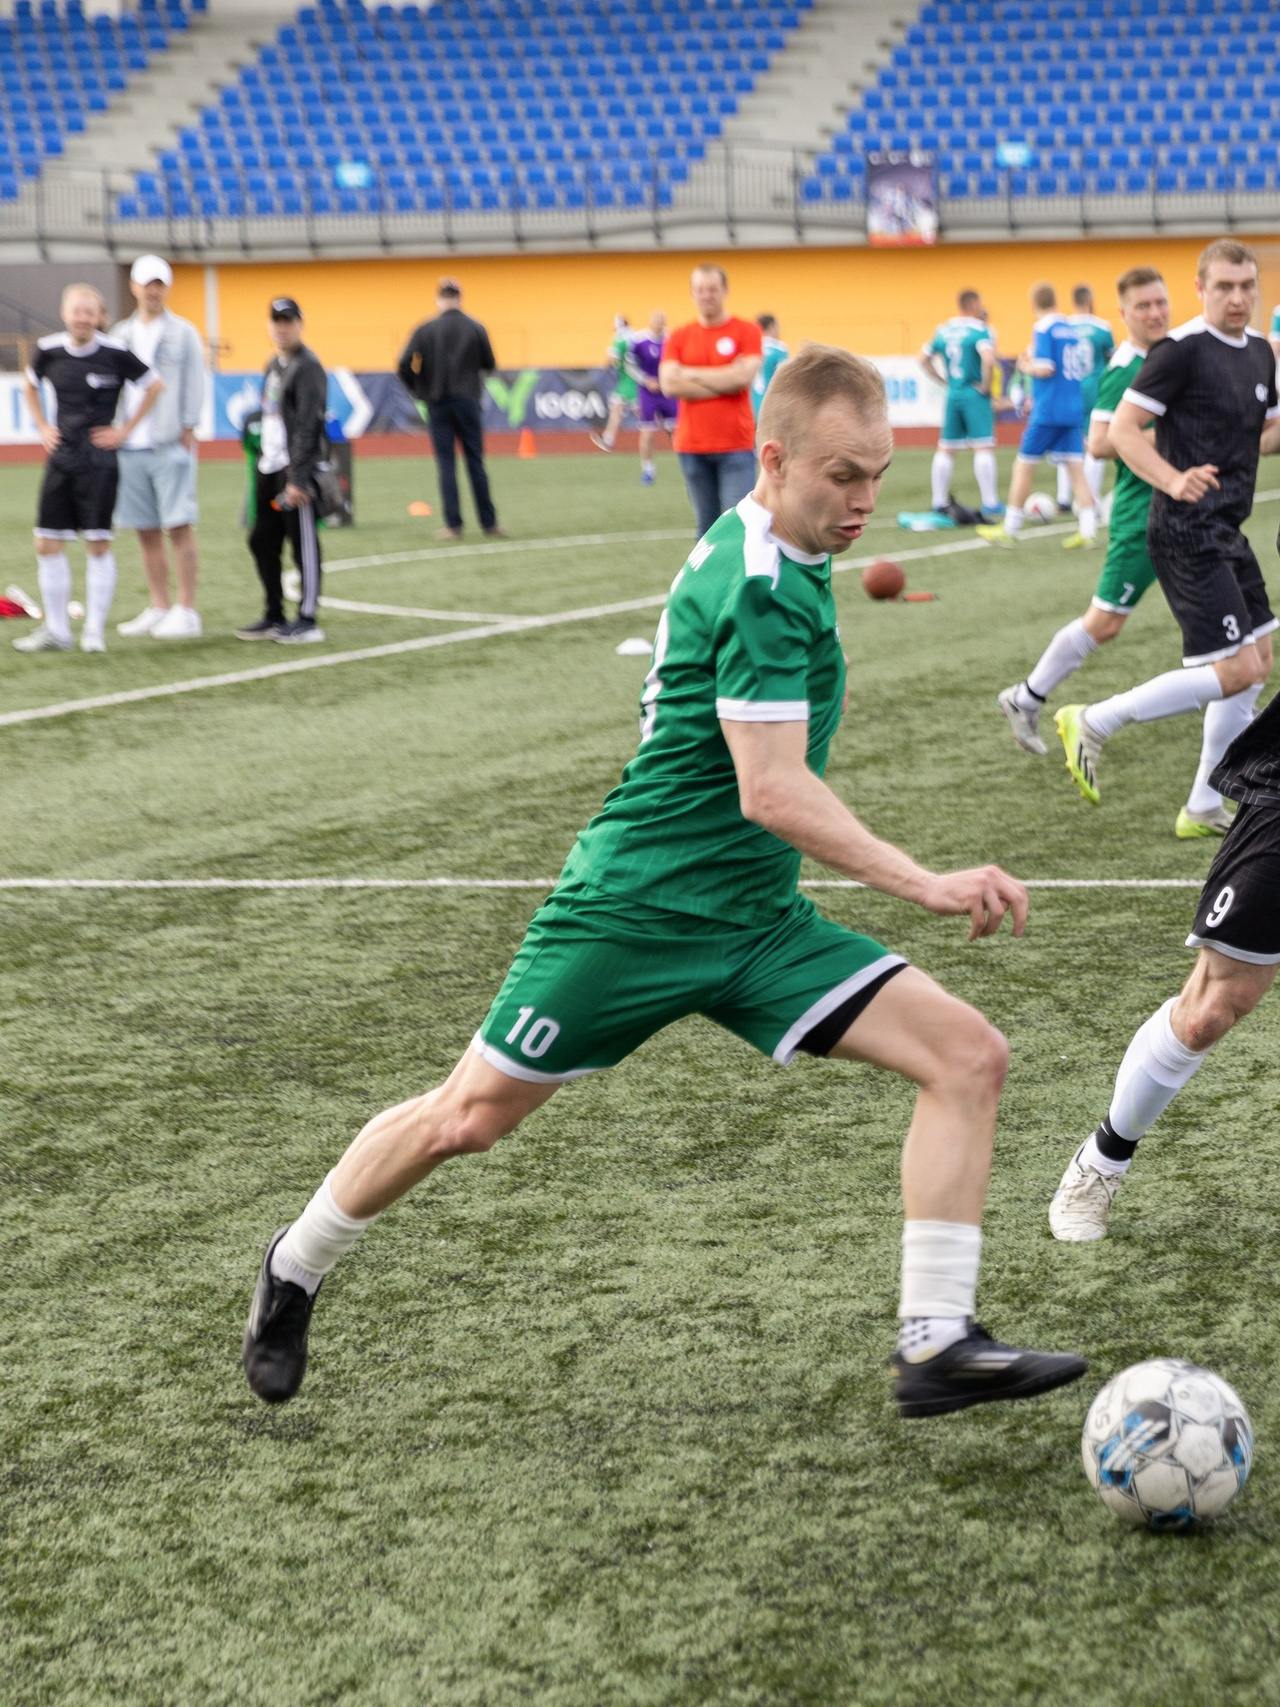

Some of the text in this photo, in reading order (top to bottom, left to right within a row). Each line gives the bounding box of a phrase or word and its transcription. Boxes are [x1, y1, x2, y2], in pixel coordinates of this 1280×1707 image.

[1222, 614, 1241, 641] 3
[1206, 886, 1234, 928] 9
[504, 1006, 560, 1058] 10
